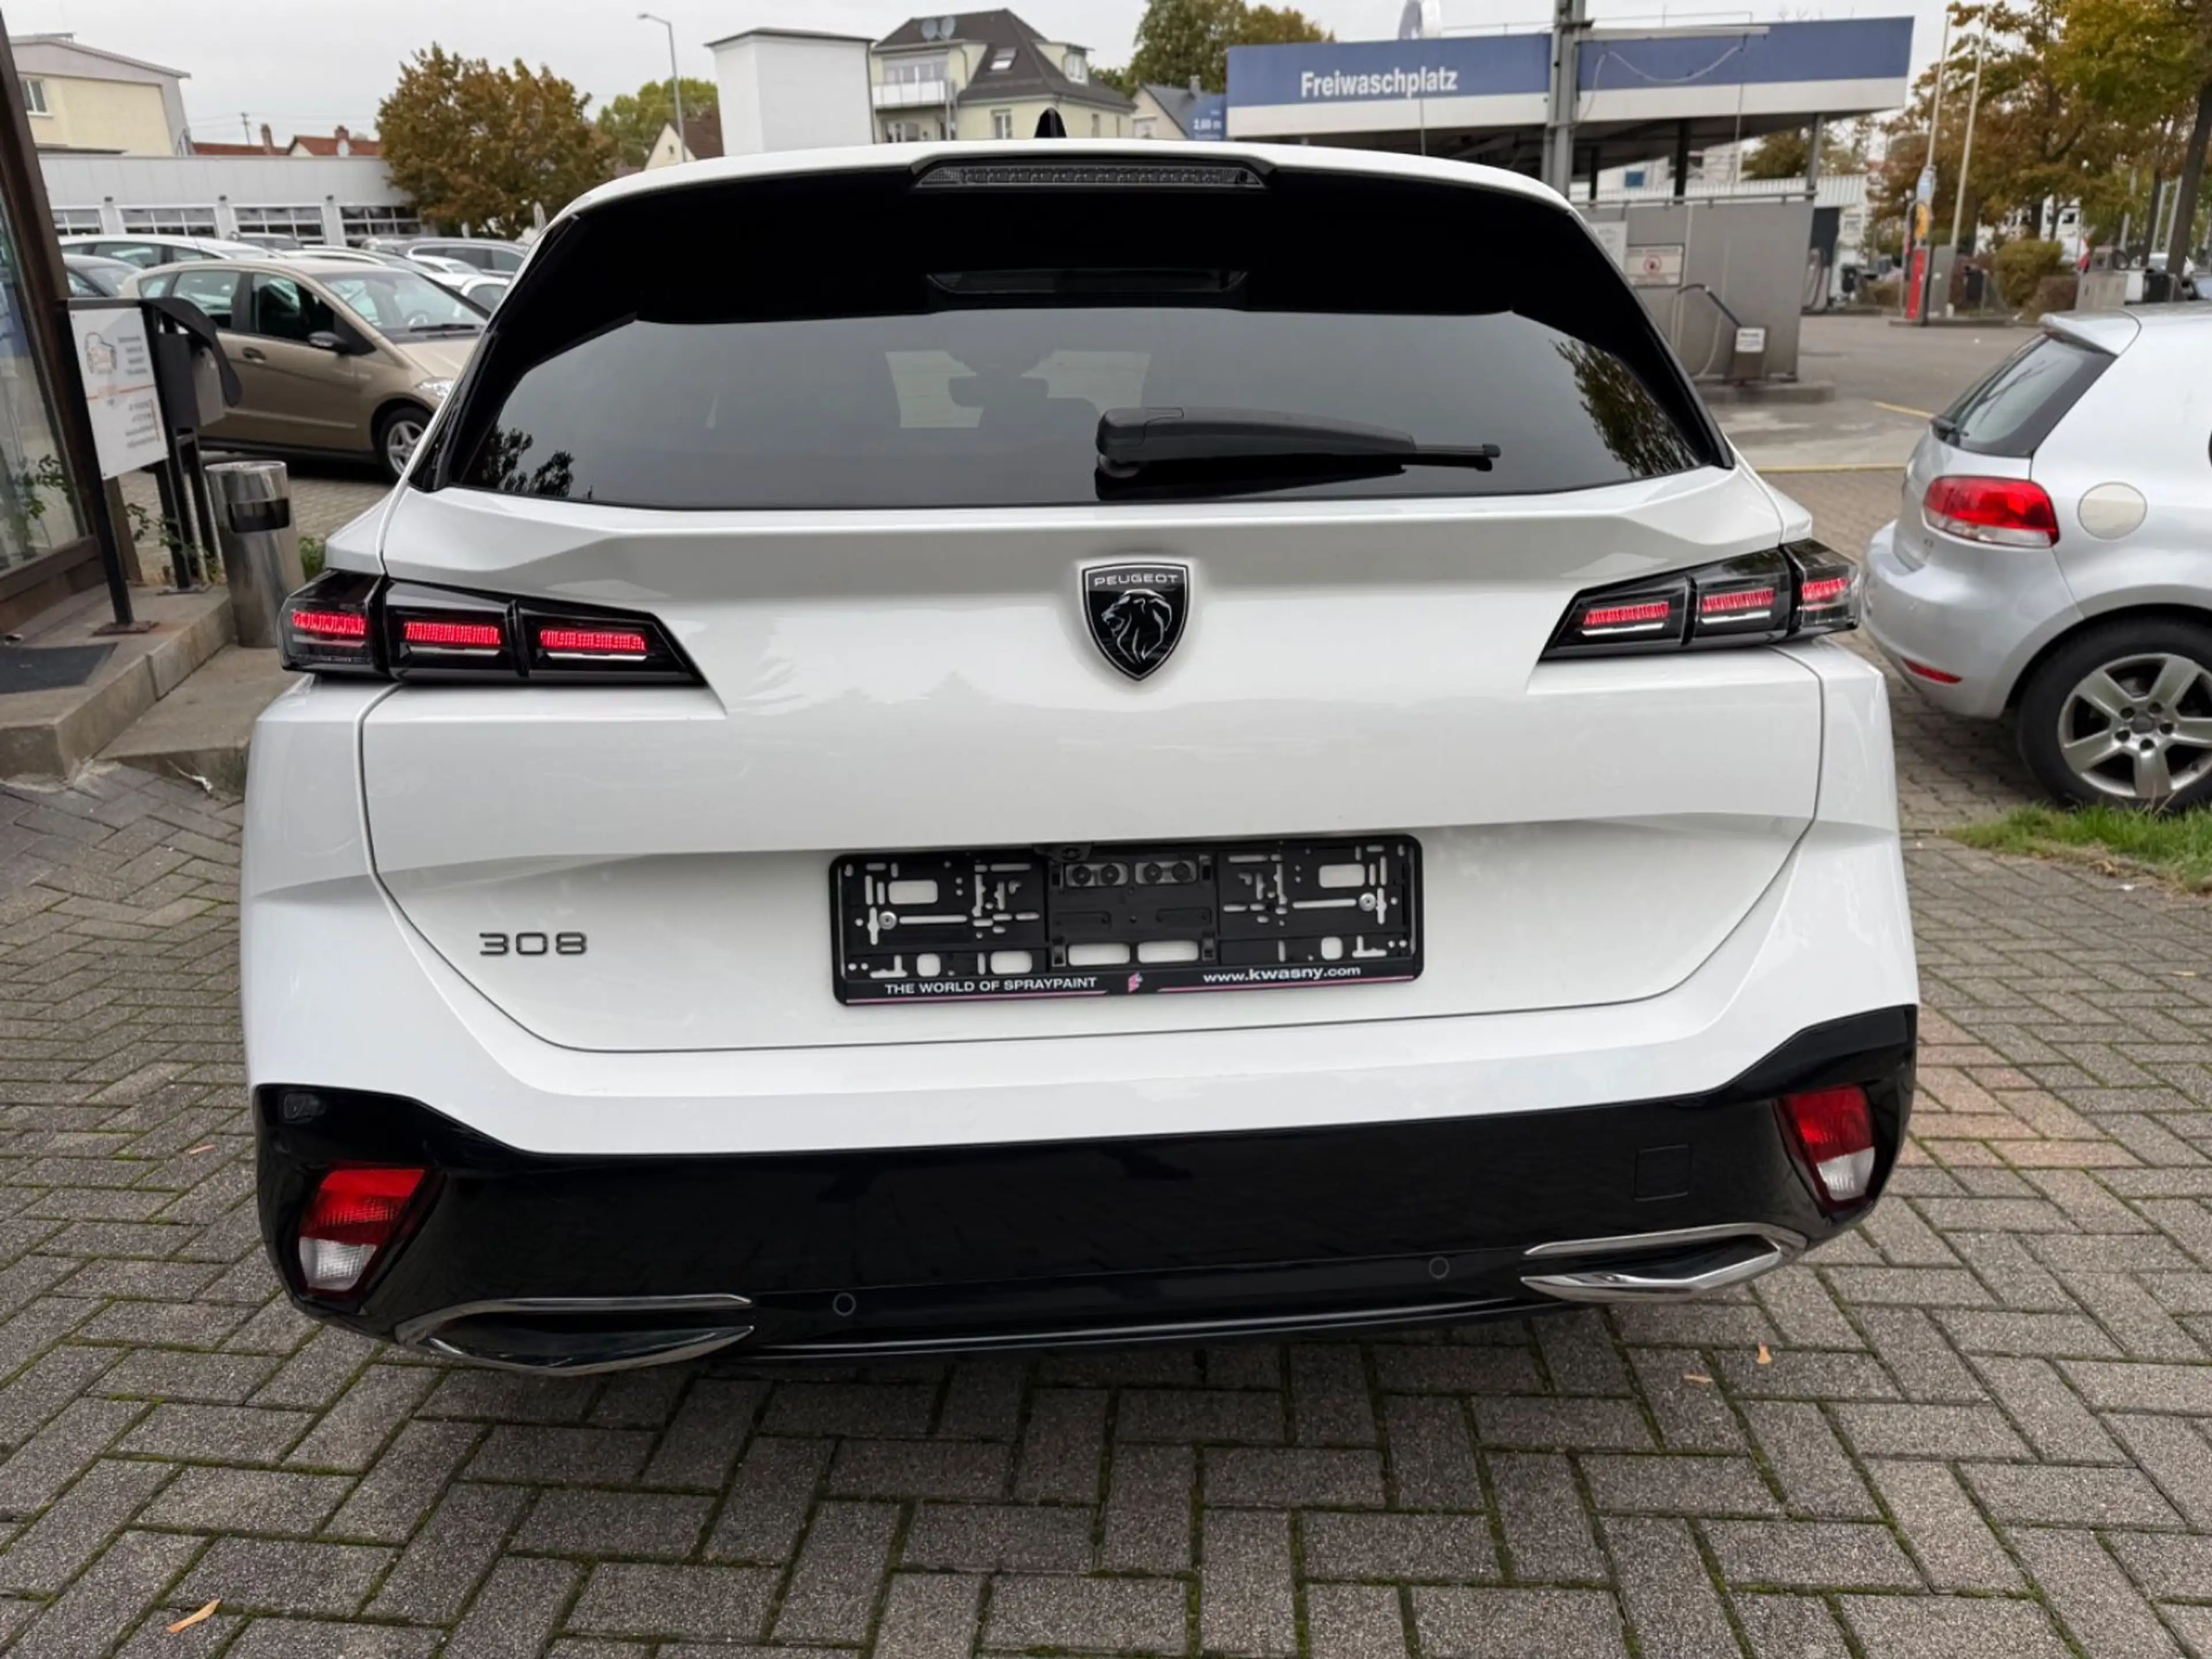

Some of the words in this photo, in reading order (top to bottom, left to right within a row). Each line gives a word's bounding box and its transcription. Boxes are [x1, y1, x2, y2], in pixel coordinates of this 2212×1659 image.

[1301, 66, 1458, 99] Freiwaschplatz
[1094, 573, 1179, 587] PEUGEOT
[479, 932, 588, 956] 308
[1203, 966, 1361, 982] www.kwasny.com
[885, 983, 915, 994] THE
[919, 981, 975, 993] WORLD
[979, 980, 1000, 991] OF
[1003, 977, 1097, 991] SPRAYPAINT
